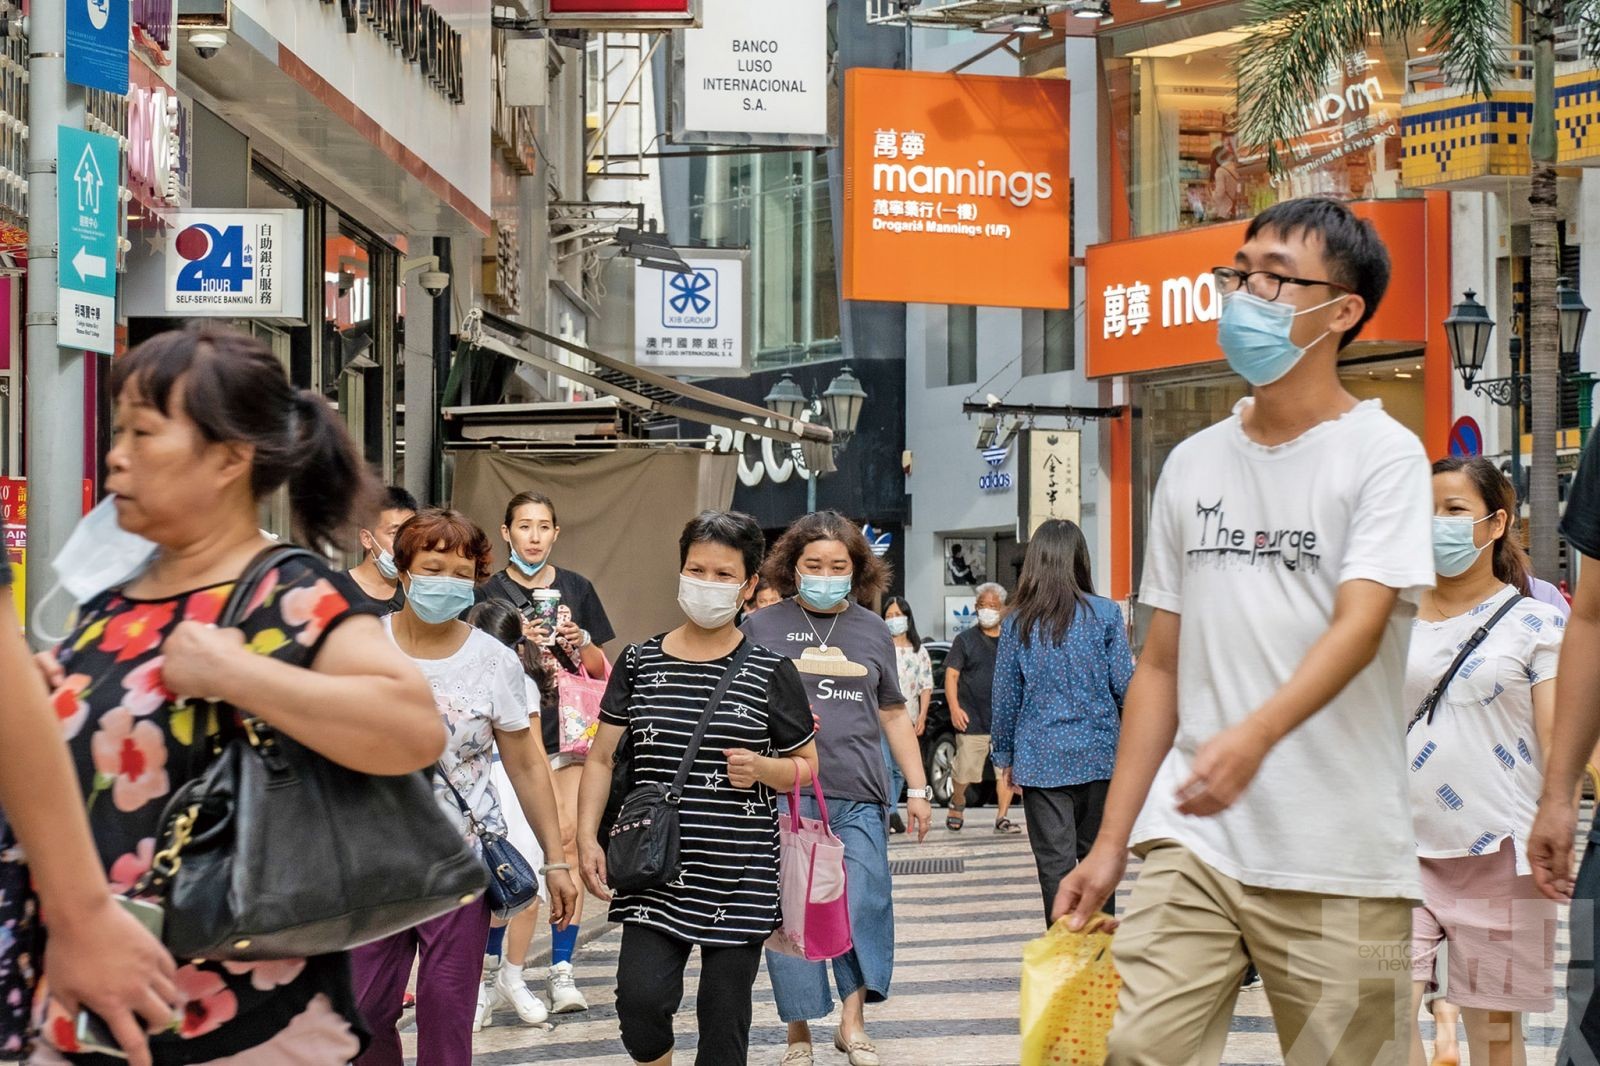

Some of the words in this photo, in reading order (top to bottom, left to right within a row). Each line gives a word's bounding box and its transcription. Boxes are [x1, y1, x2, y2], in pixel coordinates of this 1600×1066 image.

[732, 40, 778, 53] BANCO
[738, 60, 773, 72] LUSO
[703, 78, 807, 93] INTERNACIONAL
[743, 98, 767, 111] S.A.
[873, 128, 926, 160] 萬寧
[873, 160, 1053, 207] mannings
[926, 220, 982, 236] Mannings
[985, 223, 1011, 239] (1/F)
[176, 223, 253, 292] 24
[244, 244, 253, 265] 小時
[259, 223, 272, 304] 自助銀行服務
[201, 279, 231, 292] HOUR
[176, 295, 222, 304] SELF-SERVICE
[224, 296, 254, 304] BANKING
[1103, 281, 1150, 339] 萬寧
[684, 316, 711, 325] GROUP
[646, 337, 734, 350] 澳門國際銀行
[979, 470, 1011, 489] adidas
[1197, 497, 1246, 547] The
[1251, 528, 1317, 571] purge
[786, 632, 814, 642] SUN
